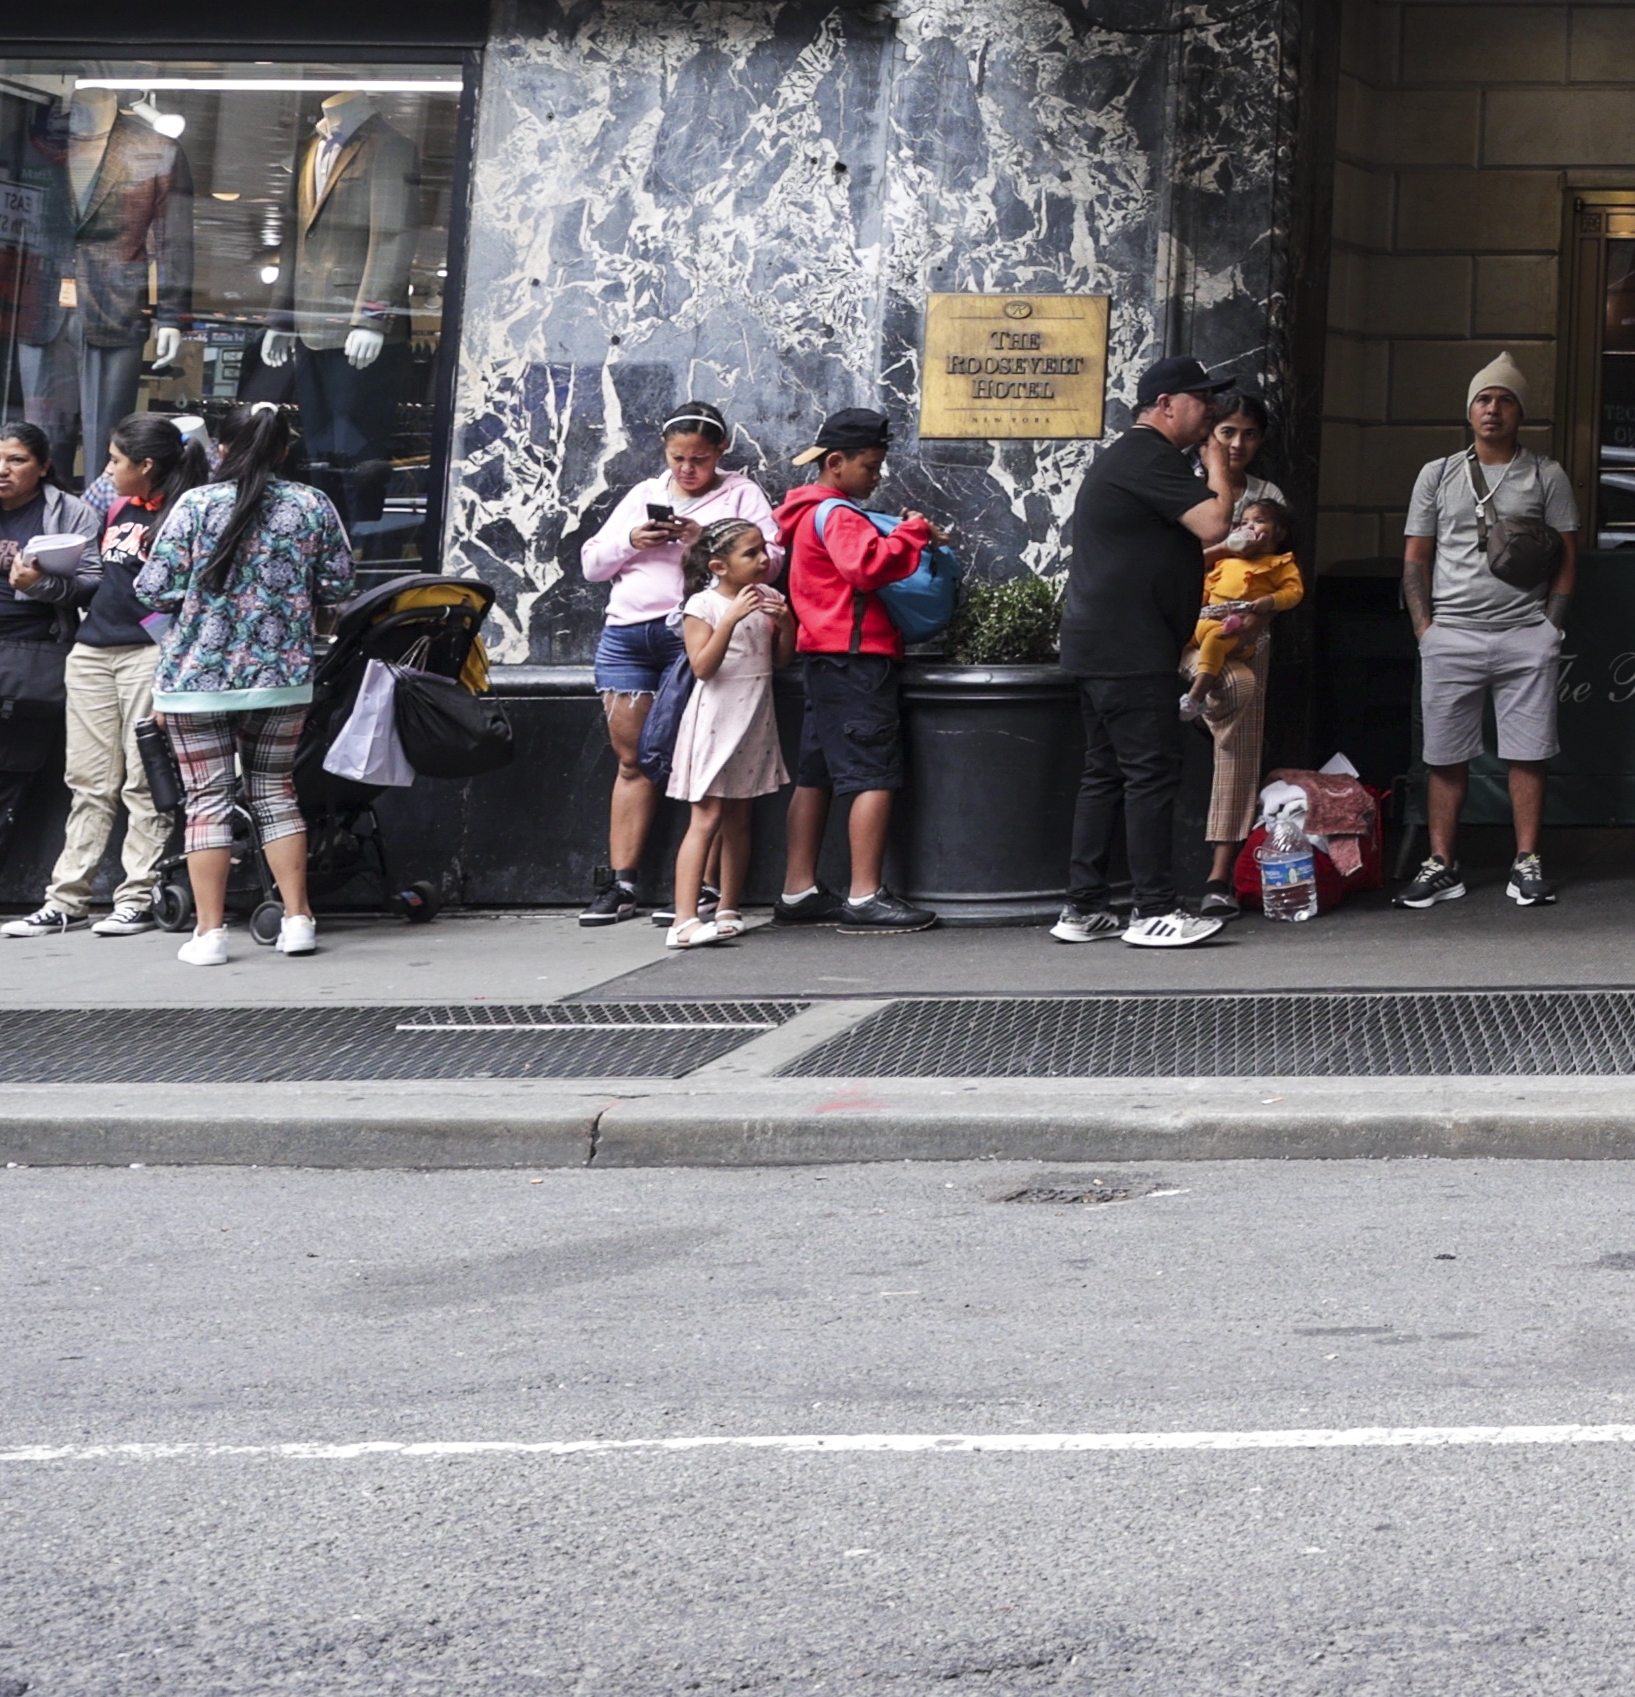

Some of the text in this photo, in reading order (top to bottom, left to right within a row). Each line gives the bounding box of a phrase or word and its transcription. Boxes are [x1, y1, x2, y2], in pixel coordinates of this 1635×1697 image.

[991, 331, 1041, 350] THE
[946, 355, 1084, 375] ROOSEVELT
[972, 378, 1055, 399] HOTEL
[1556, 653, 1592, 702] he
